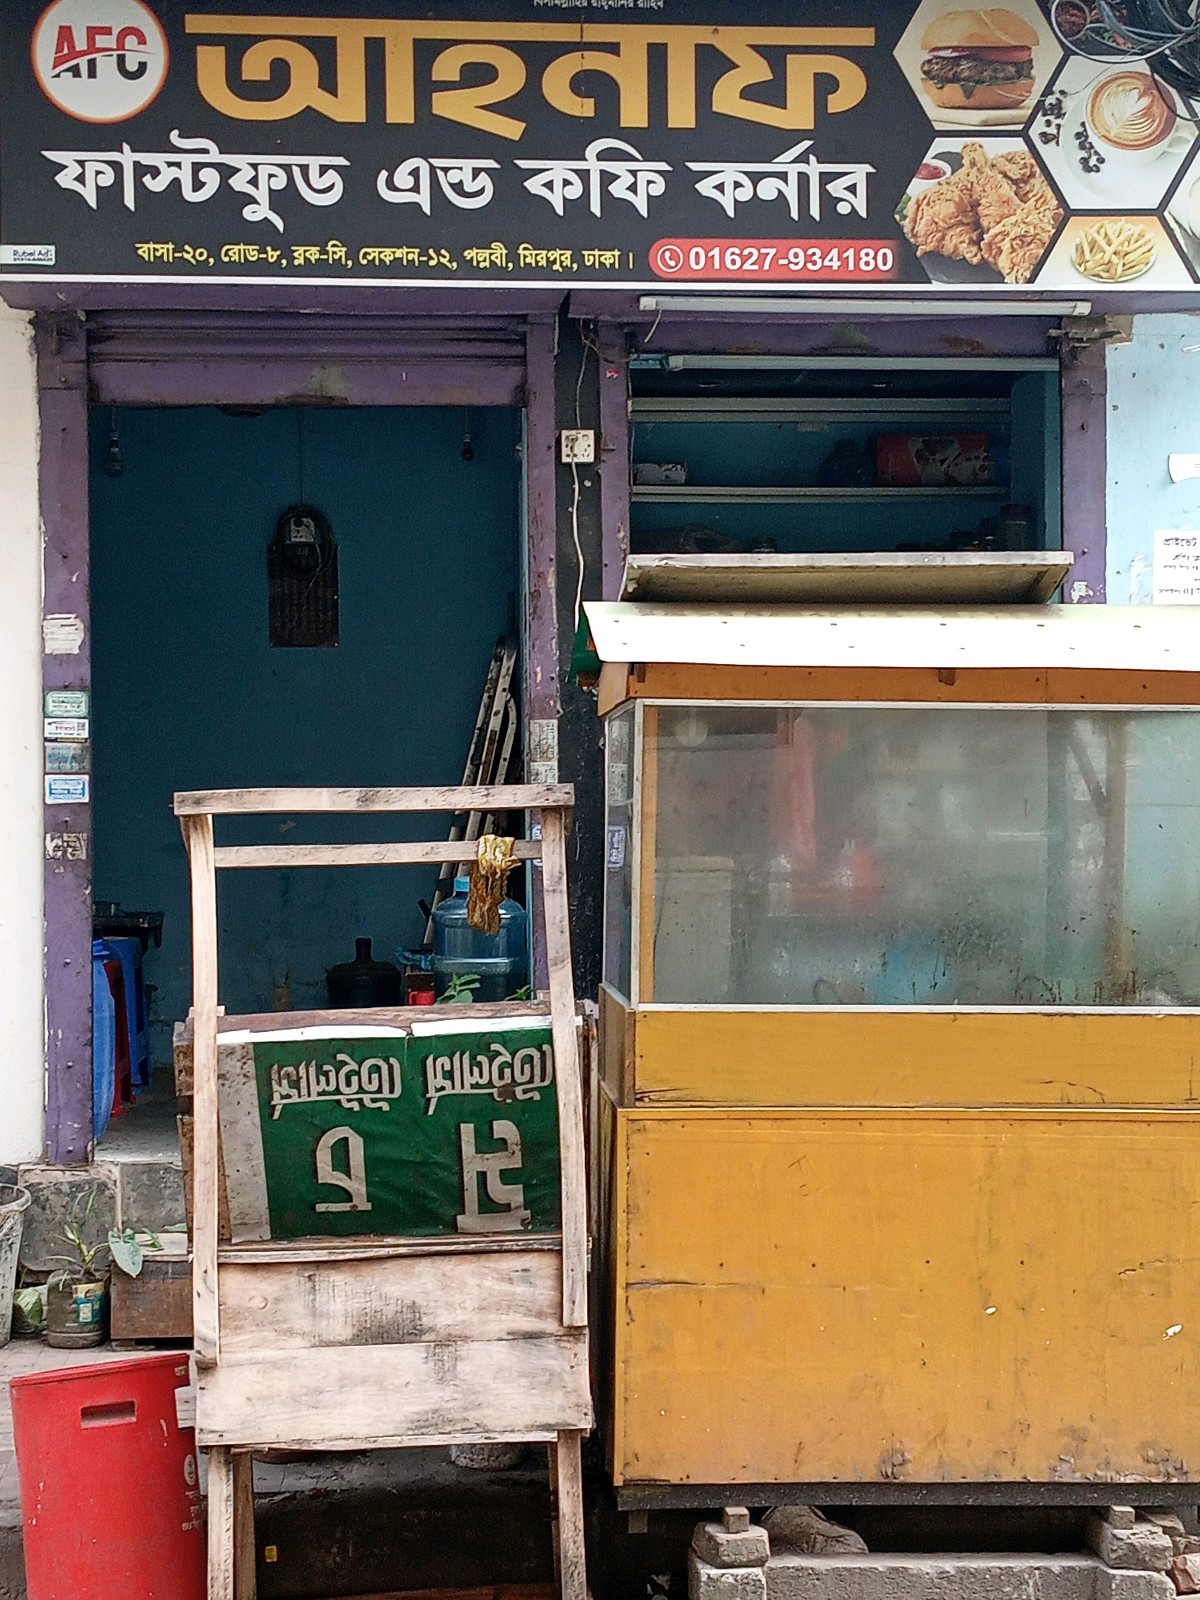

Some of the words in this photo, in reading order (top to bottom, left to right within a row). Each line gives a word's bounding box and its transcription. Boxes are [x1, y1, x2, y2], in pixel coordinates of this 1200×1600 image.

[51, 24, 149, 80] AFC
[185, 14, 875, 141] আহনাফ
[41, 130, 351, 233] ফাস্টফুড
[376, 157, 501, 214] এন্ড
[513, 138, 673, 219] কফি
[684, 140, 877, 222] কর্নার
[135, 241, 215, 266] বাসা-২০,
[220, 243, 287, 268] রোড-৮,
[291, 240, 353, 268] ব্লক-সি,
[359, 246, 458, 271] সেকশন-১২,
[463, 242, 514, 271] পল্লবী,
[517, 243, 578, 272] মিরপুর,
[688, 247, 894, 272] 01627-934180
[270, 1053, 402, 1120] টেইলার্স
